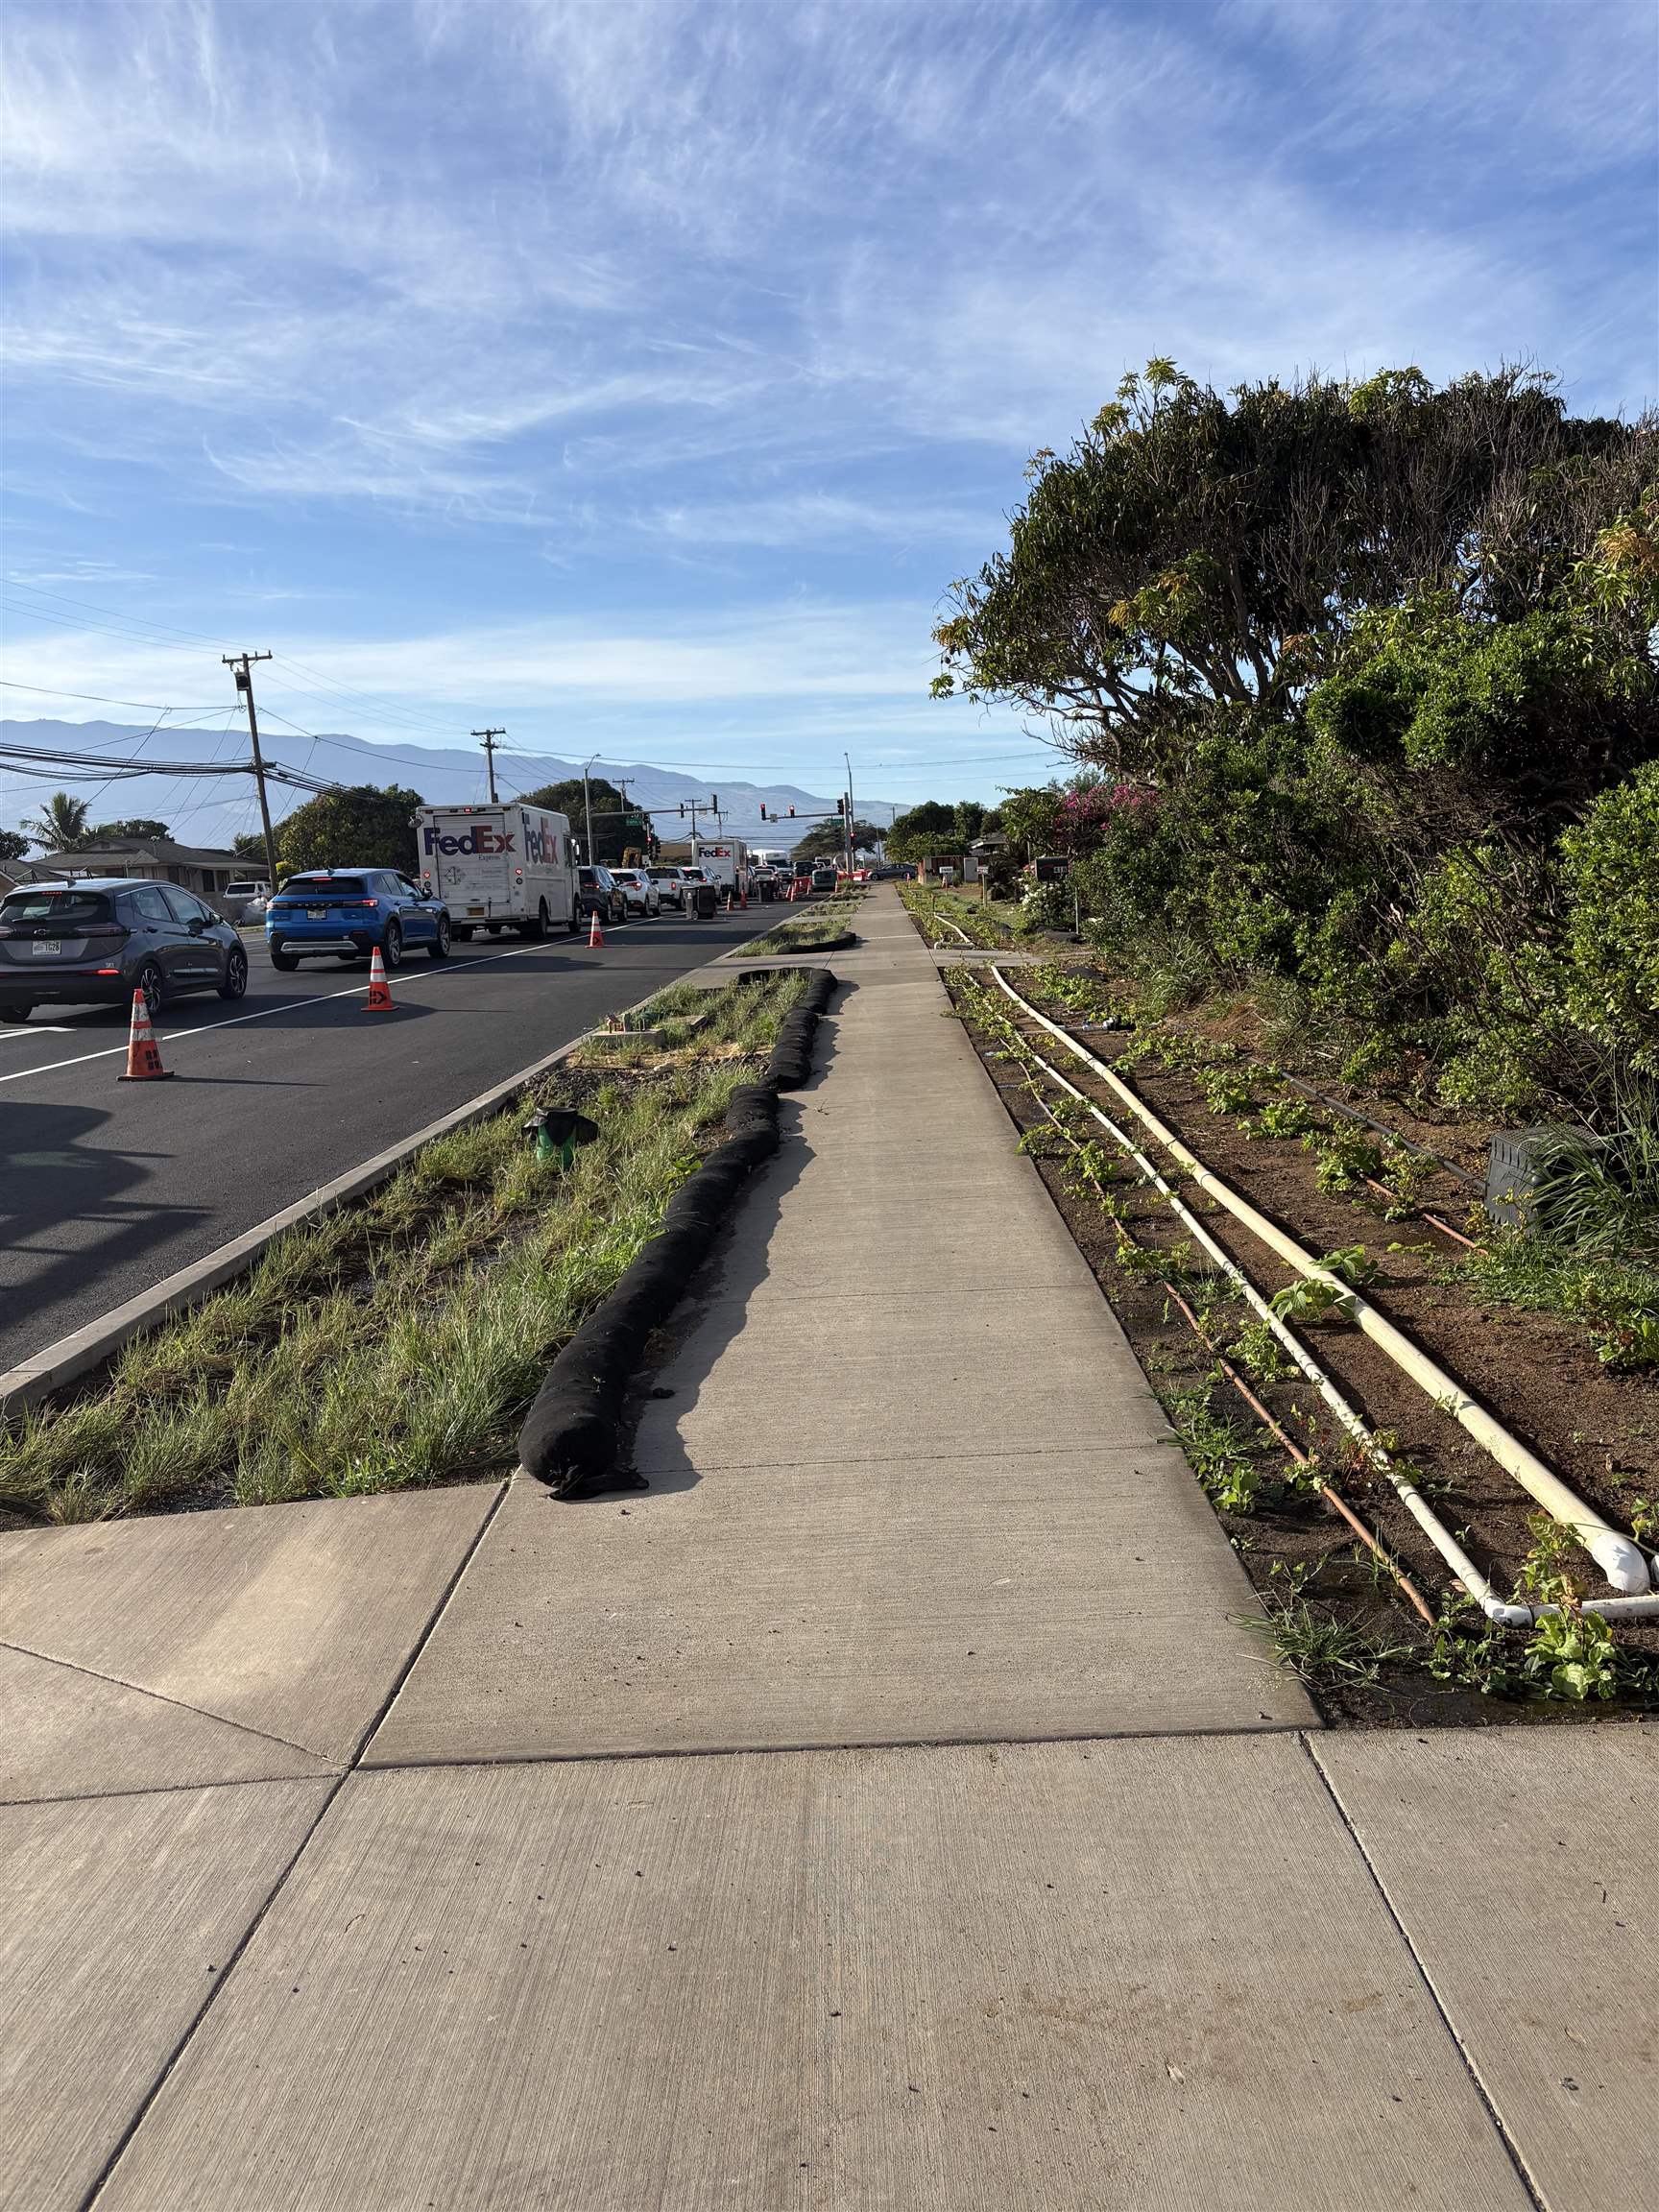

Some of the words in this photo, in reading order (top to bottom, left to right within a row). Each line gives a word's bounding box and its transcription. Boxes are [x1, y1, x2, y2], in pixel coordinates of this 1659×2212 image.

[423, 826, 517, 856] FedEx
[522, 811, 558, 864] FedEx
[699, 847, 731, 857] FedEx
